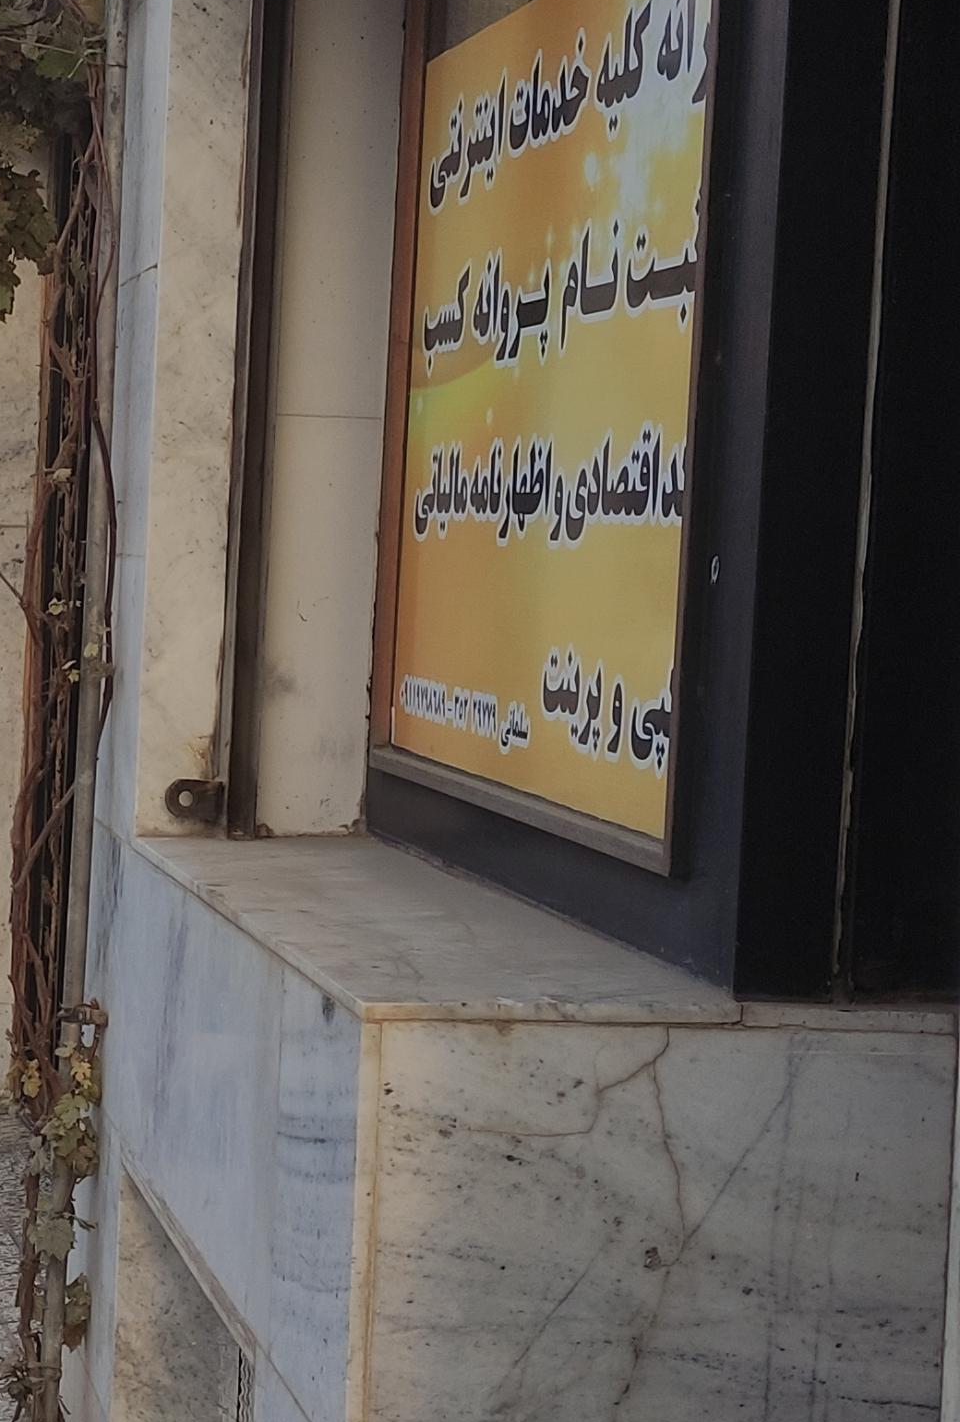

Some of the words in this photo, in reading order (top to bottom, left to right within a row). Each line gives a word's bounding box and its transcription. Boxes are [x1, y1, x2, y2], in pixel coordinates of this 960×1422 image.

[509, 34, 590, 150] خدمات
[596, 0, 652, 132] کلیه
[429, 75, 506, 209] اینترنتی
[424, 264, 471, 376] کسب
[473, 253, 550, 362] پروانه
[560, 219, 619, 351] نام
[415, 445, 467, 535] مالیاتی
[549, 475, 564, 541] و
[565, 430, 661, 541] اقتصادی
[543, 651, 601, 753] پرینت
[607, 683, 623, 753] و
[631, 668, 674, 770] پی
